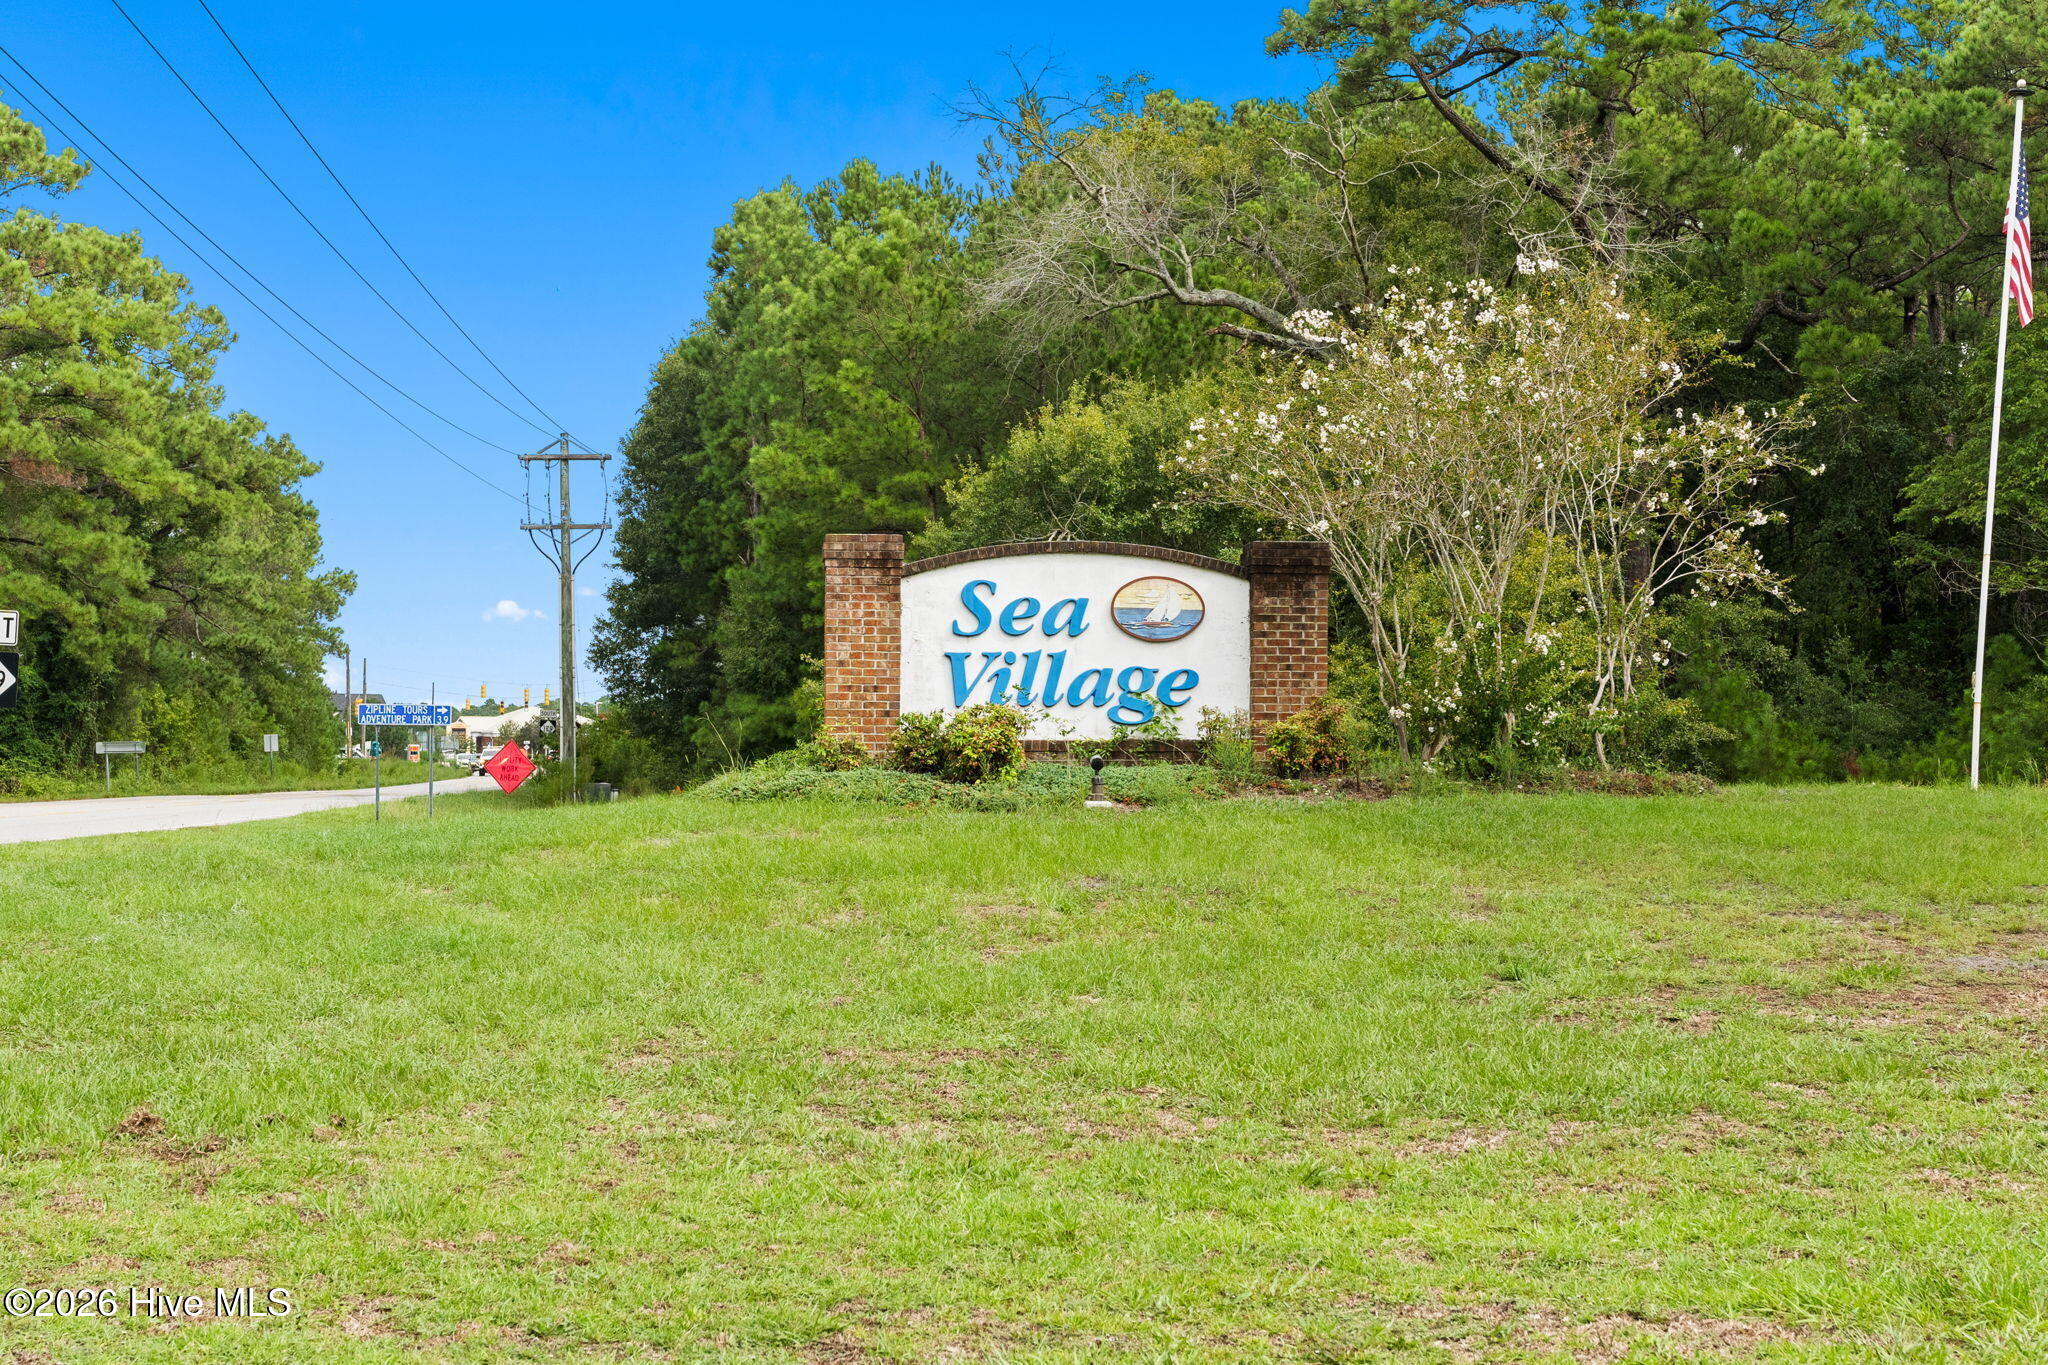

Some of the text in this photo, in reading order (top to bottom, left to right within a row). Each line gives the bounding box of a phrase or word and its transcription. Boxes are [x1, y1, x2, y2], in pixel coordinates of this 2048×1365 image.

[952, 579, 1090, 637] Sea
[944, 648, 1199, 725] Village
[360, 714, 432, 724] ADVENTURE PARK
[365, 705, 428, 714] ZIPLINE TOURS
